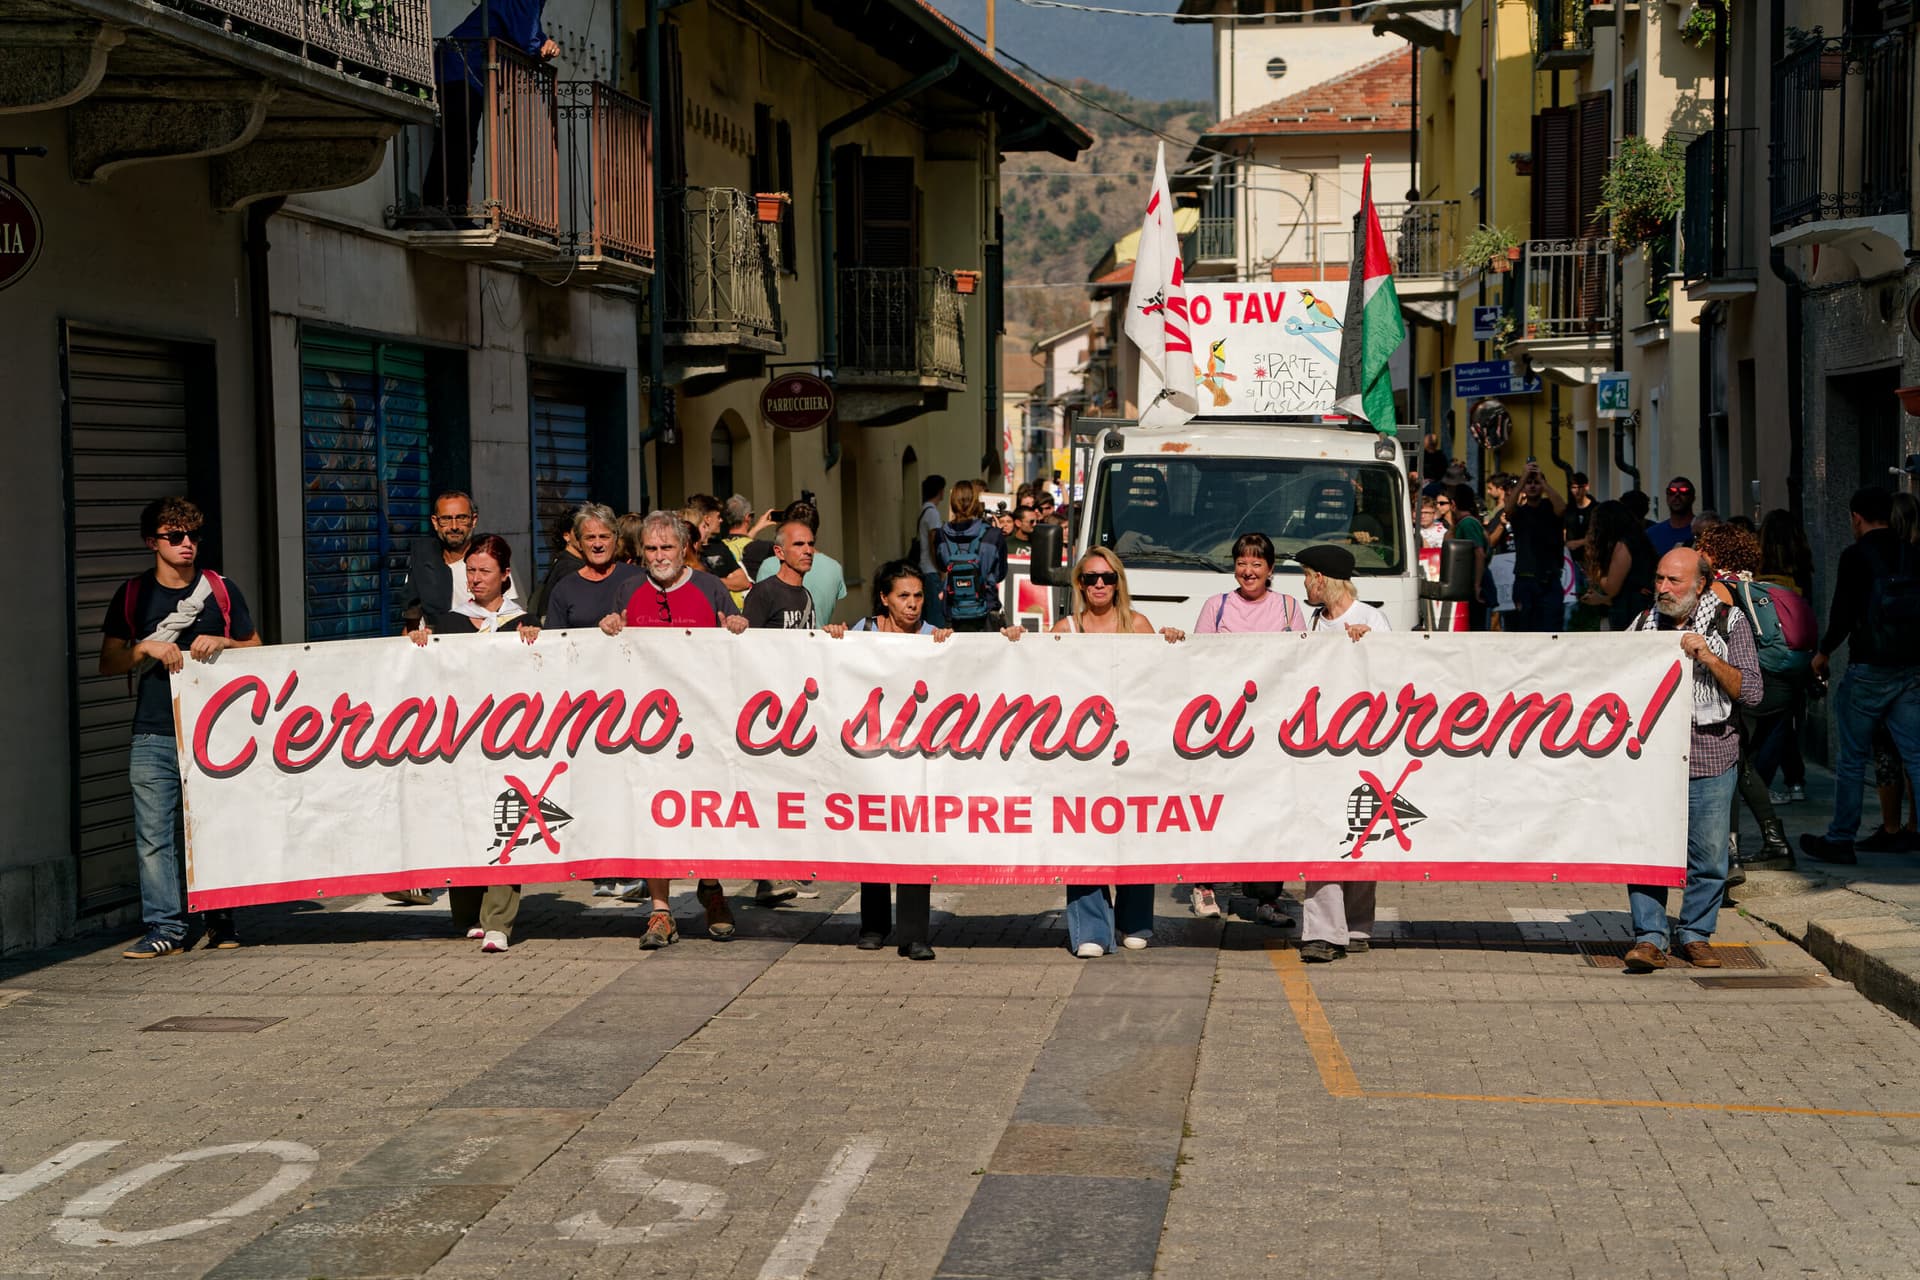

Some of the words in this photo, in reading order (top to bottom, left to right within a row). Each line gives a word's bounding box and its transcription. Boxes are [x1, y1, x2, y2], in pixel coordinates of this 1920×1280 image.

[1223, 291, 1287, 324] TAV
[1268, 352, 1323, 379] PARTE
[1252, 380, 1336, 400] TORNA
[1458, 383, 1481, 393] Rivoli
[767, 396, 829, 412] PARRUCCHIERA
[193, 670, 696, 779] C'eravamo,
[735, 677, 820, 758] ci
[841, 679, 1130, 767] siamo,
[1172, 679, 1259, 762] ci
[1278, 659, 1684, 763] saremo!
[650, 790, 760, 829] ORA
[777, 792, 807, 829] E
[823, 793, 1033, 834] SEMPRE
[1052, 794, 1225, 834] NOTAV
